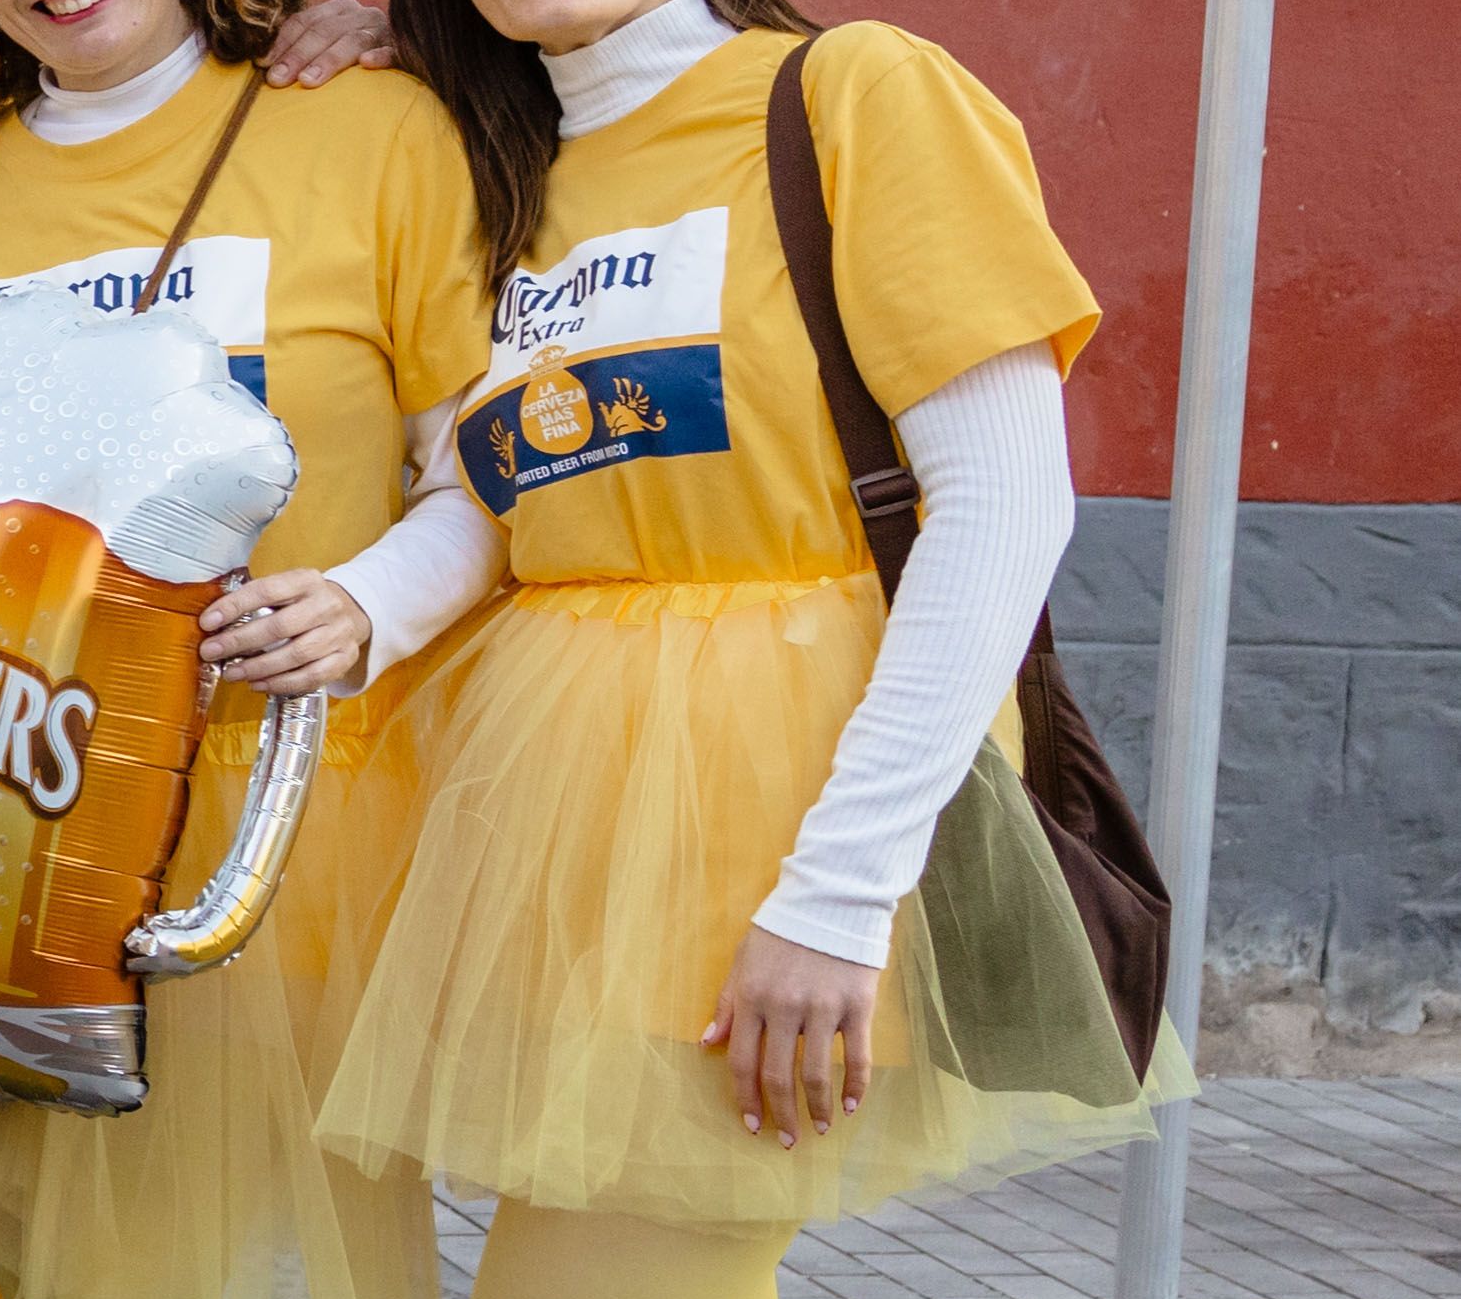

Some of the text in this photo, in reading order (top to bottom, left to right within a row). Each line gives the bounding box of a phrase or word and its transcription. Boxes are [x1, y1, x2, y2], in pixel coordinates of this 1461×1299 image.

[491, 251, 657, 345] Corona
[517, 315, 586, 354] Extra
[538, 380, 558, 398] LA
[521, 386, 585, 420] CERVEZA
[537, 405, 575, 427] MAS
[541, 424, 582, 442] FINA
[550, 455, 581, 476] BEER
